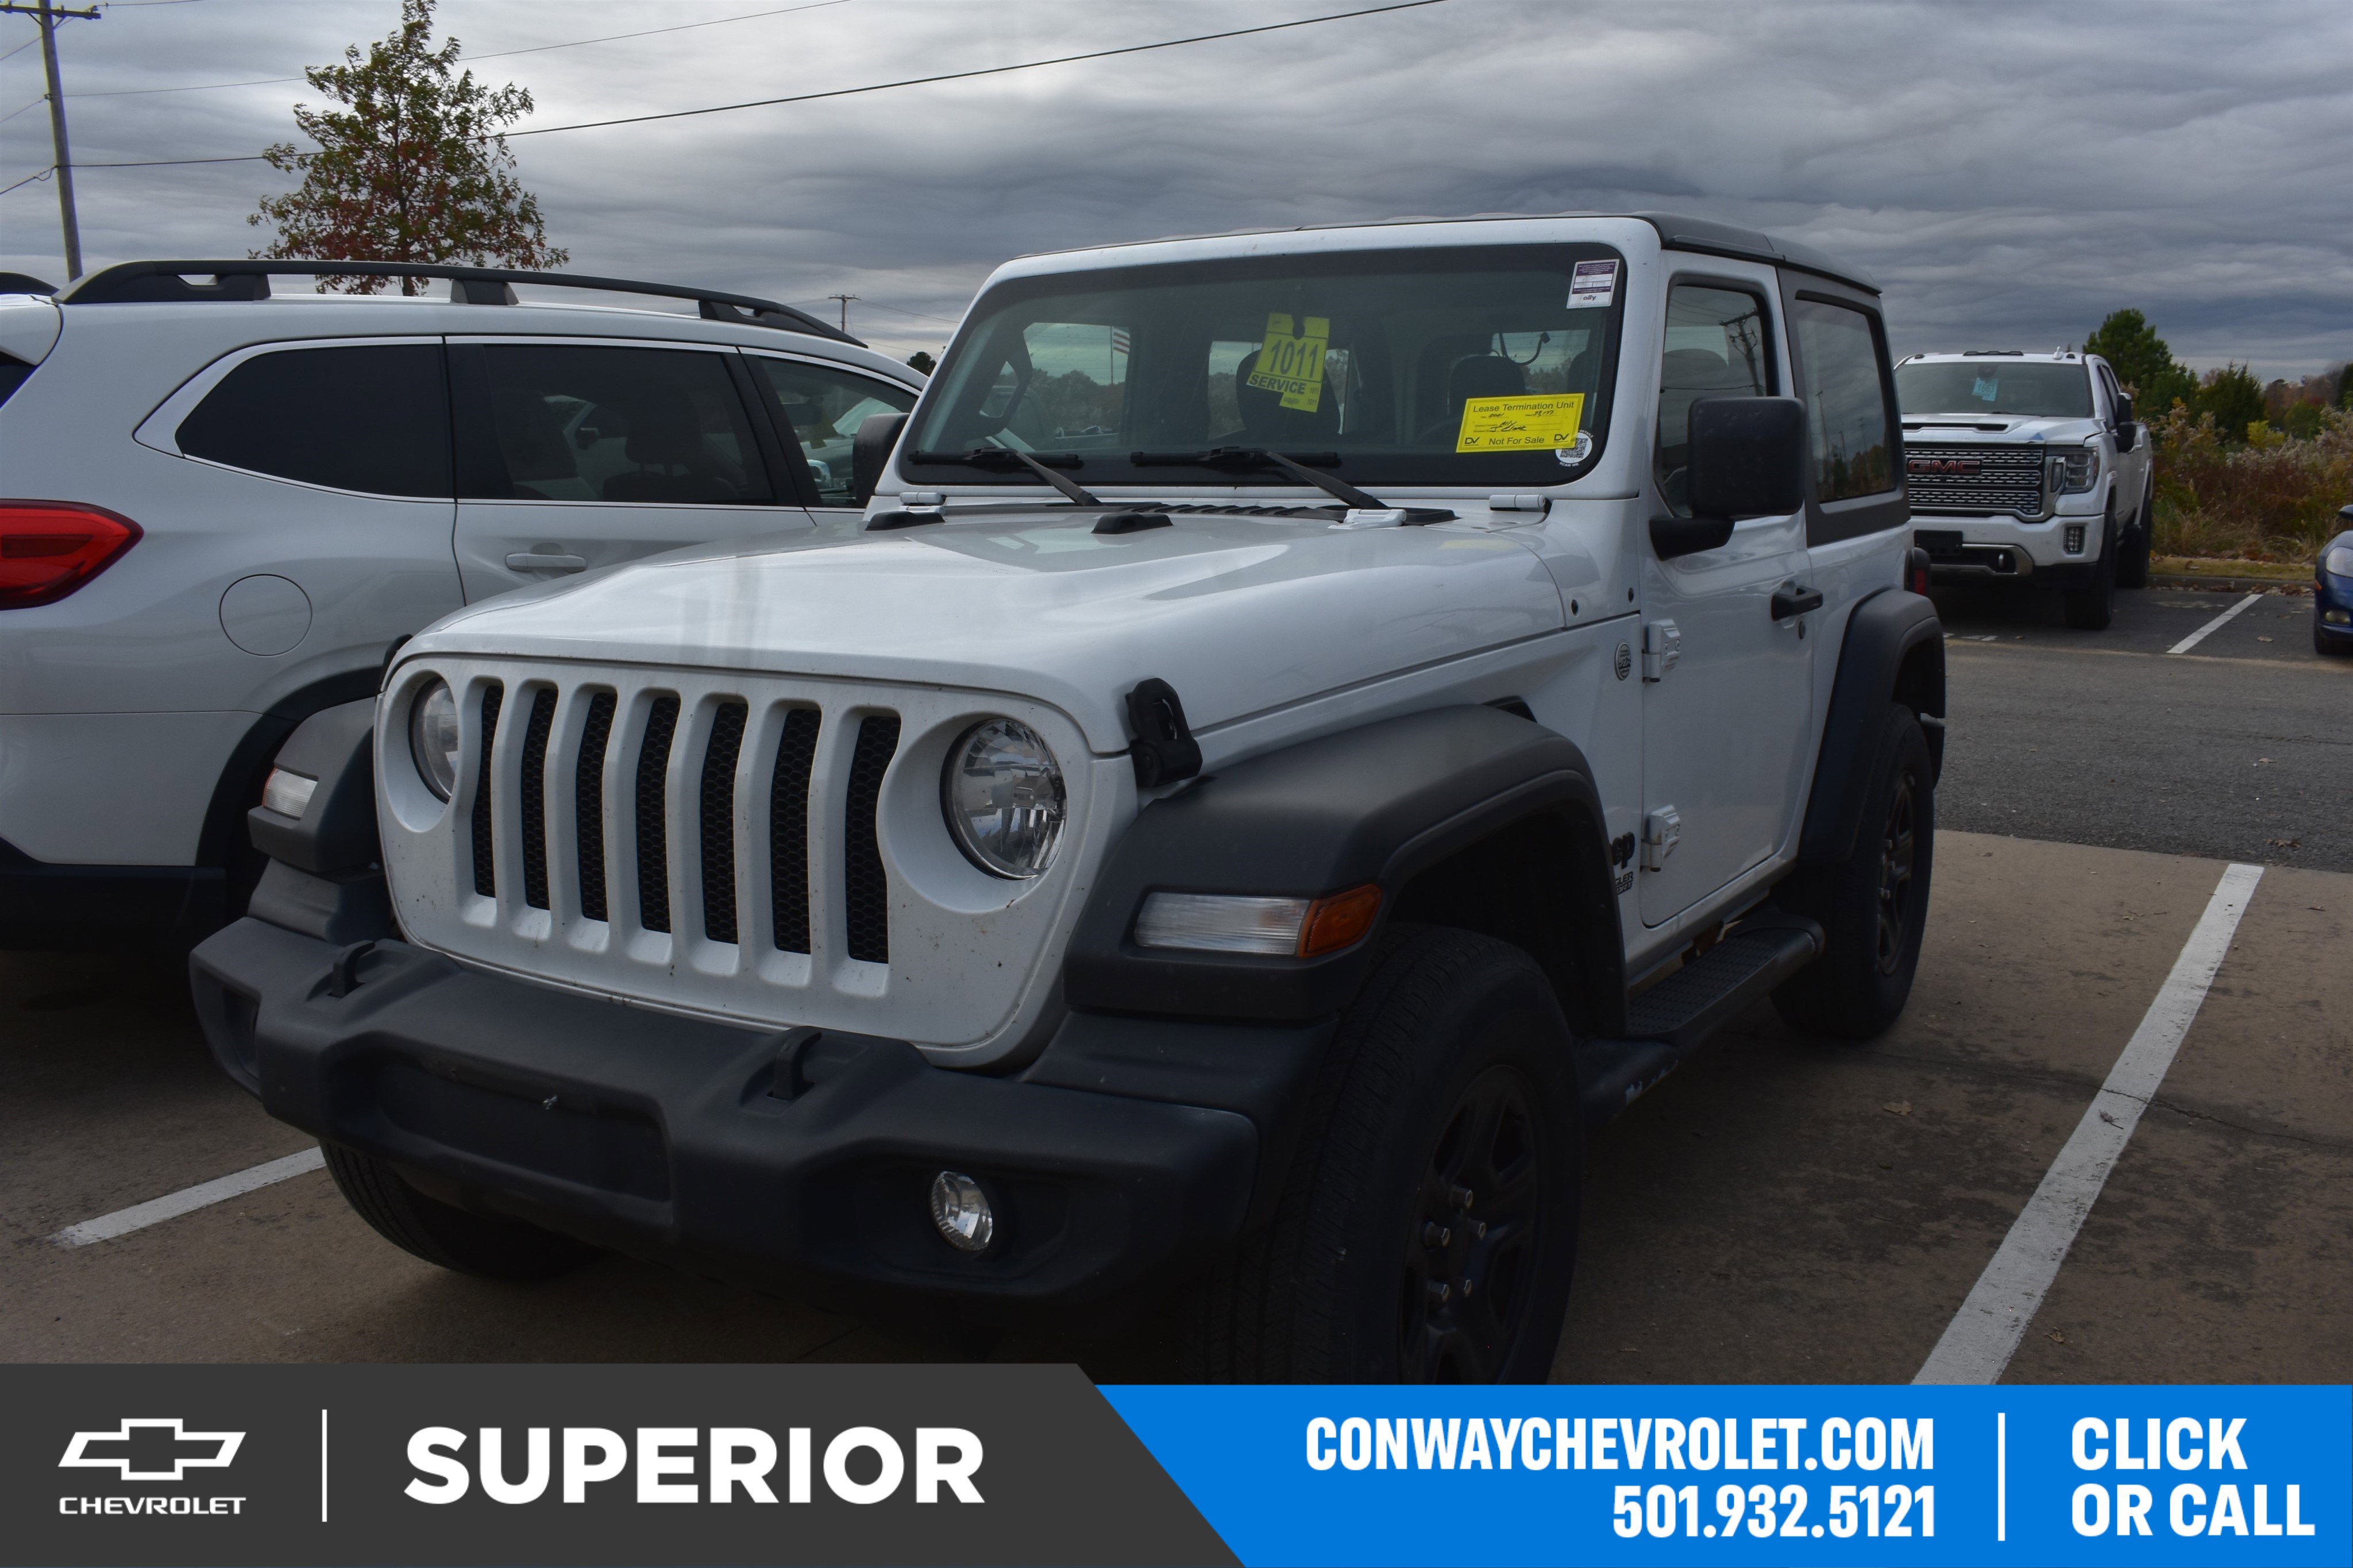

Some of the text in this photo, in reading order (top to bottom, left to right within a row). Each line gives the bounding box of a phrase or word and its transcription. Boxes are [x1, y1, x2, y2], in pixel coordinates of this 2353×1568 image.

[1268, 339, 1318, 379] 1011
[1249, 374, 1306, 395] SERVICE
[1503, 402, 1553, 411] Termination
[1909, 460, 1980, 473] GMC
